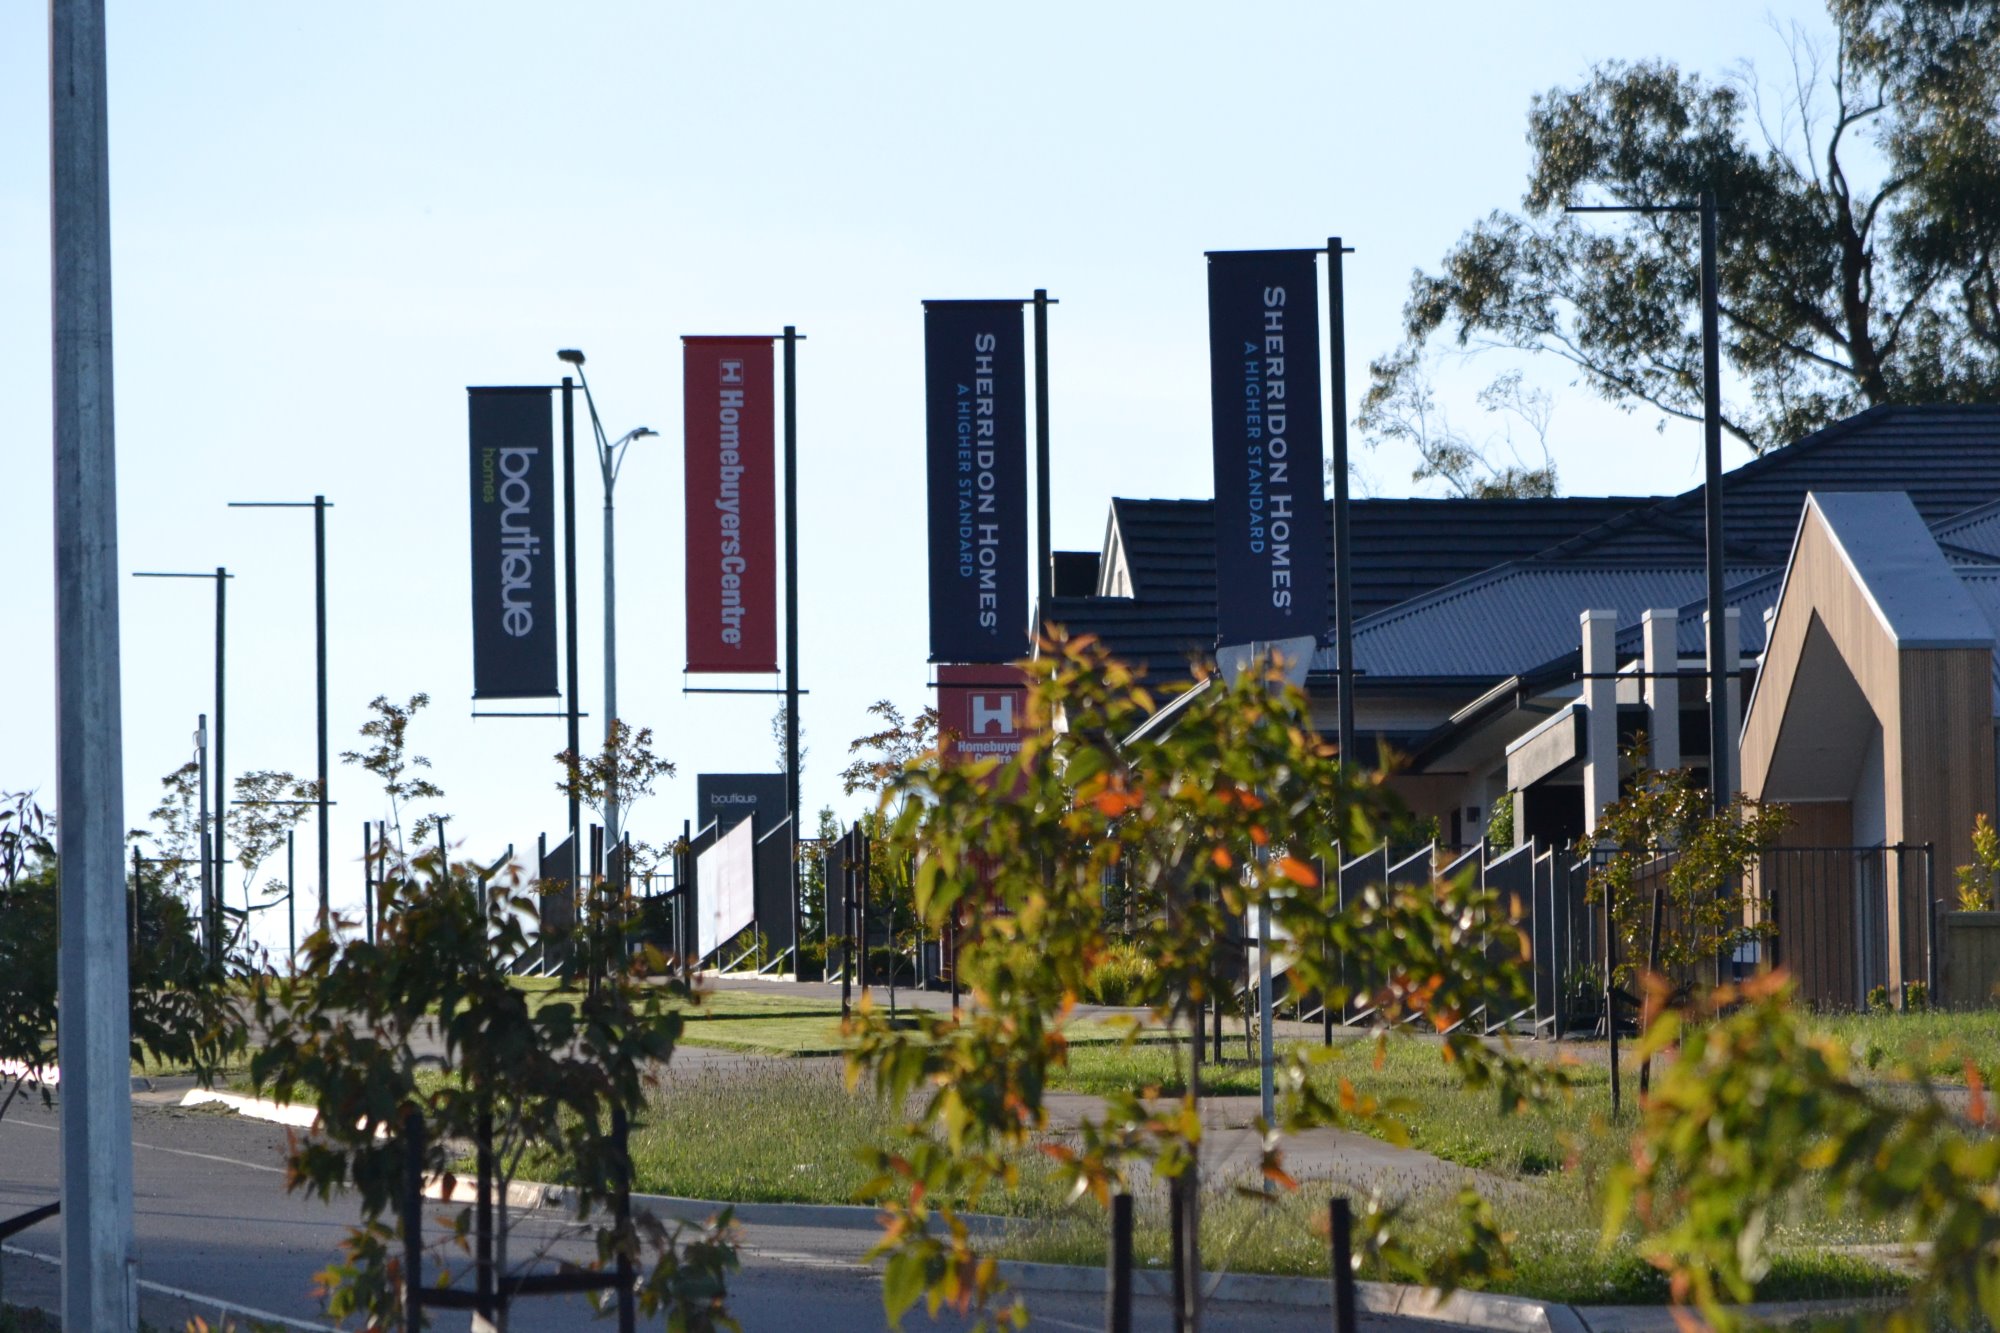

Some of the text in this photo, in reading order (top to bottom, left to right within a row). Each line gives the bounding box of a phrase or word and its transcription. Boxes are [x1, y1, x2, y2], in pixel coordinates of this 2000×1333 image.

[481, 448, 496, 503] homes
[715, 390, 746, 646] HomebuyersCentre
[957, 383, 973, 577] A HIGHER STANDARD
[974, 333, 999, 628] SHERRIDON HOMES
[1243, 342, 1265, 554] A HIGHER STANDARD
[1263, 286, 1293, 608] SHERRIDON HOMES
[972, 695, 1013, 734] H
